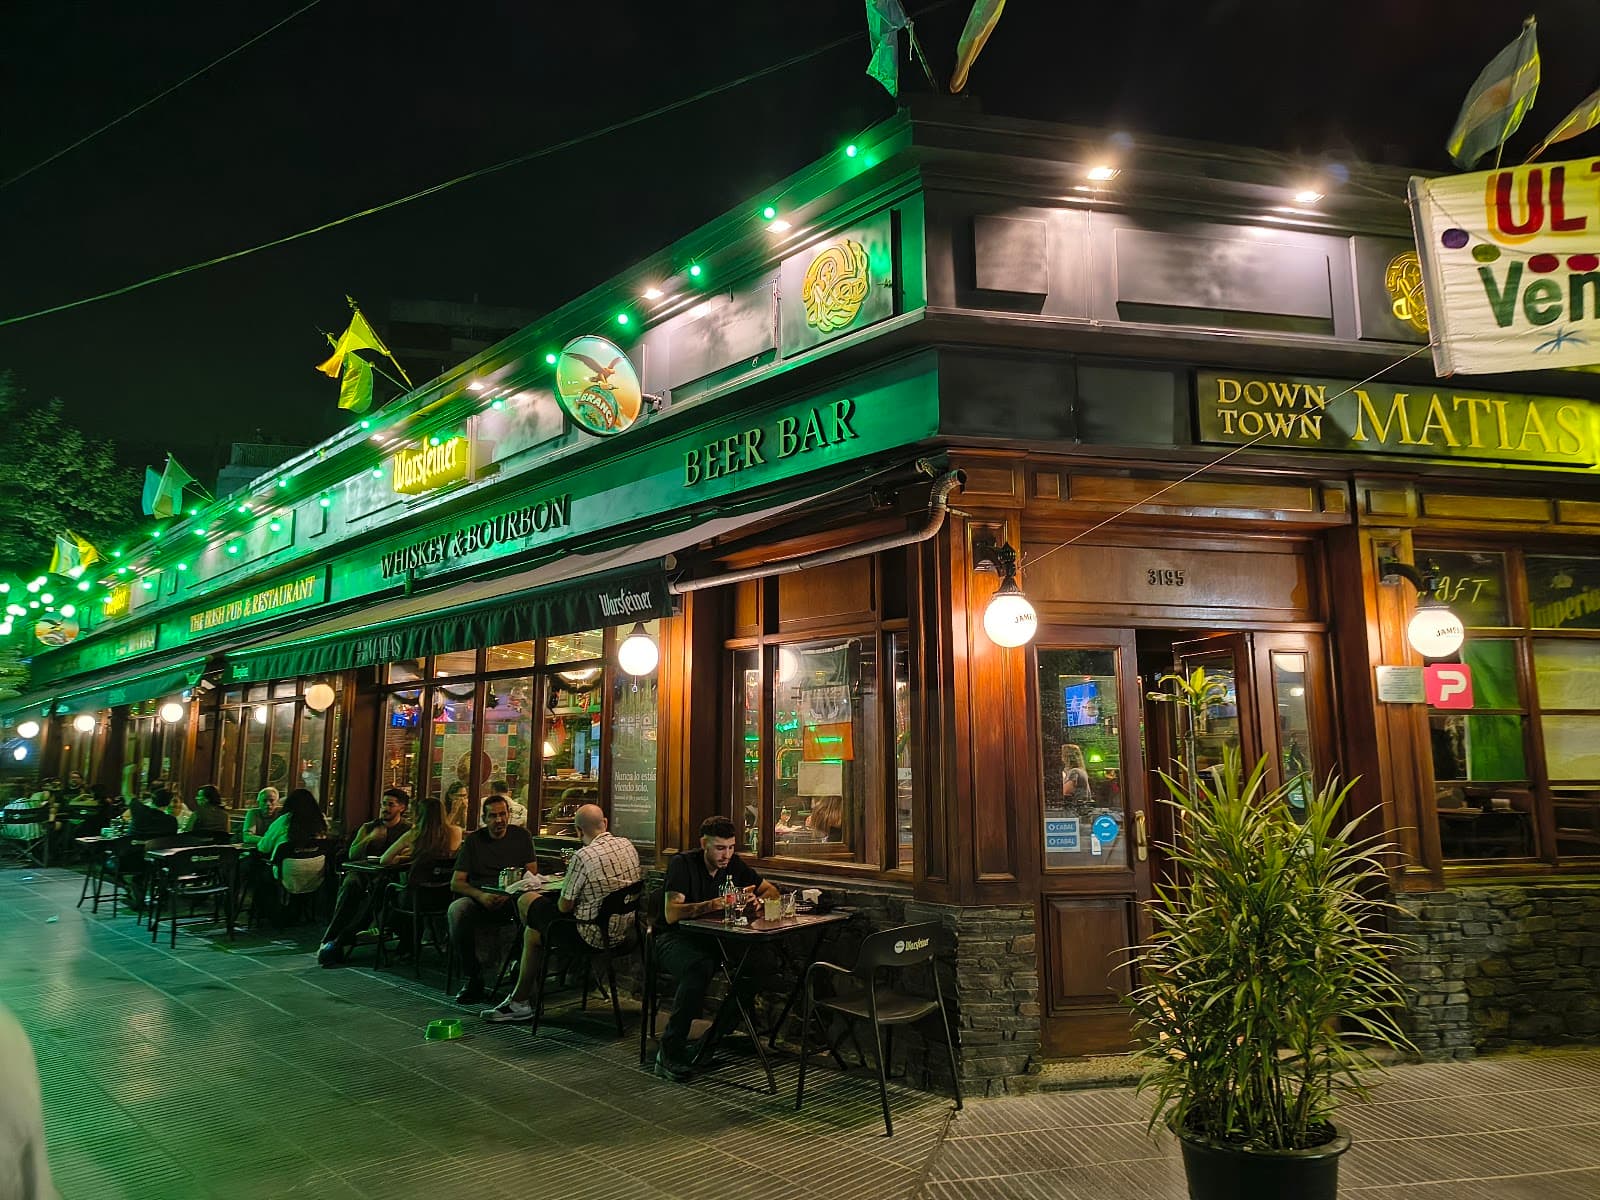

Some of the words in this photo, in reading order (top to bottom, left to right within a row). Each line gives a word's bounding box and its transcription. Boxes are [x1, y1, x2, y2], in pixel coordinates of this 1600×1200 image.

[1216, 378, 1326, 410] DOWN
[682, 428, 766, 488] BEER
[776, 399, 856, 458] BAR
[1216, 409, 1322, 440] TOWN
[1352, 390, 1585, 455] MATIAS
[393, 438, 458, 491] Warsteiner
[380, 535, 449, 579] WHISKEY
[467, 493, 573, 553] BOURBON
[190, 612, 205, 632] THE
[204, 605, 226, 629] IRISH
[226, 600, 242, 622] PUB
[252, 575, 315, 614] RESTAURANT
[598, 588, 652, 618] Warsteiner
[1147, 568, 1185, 587] 3195
